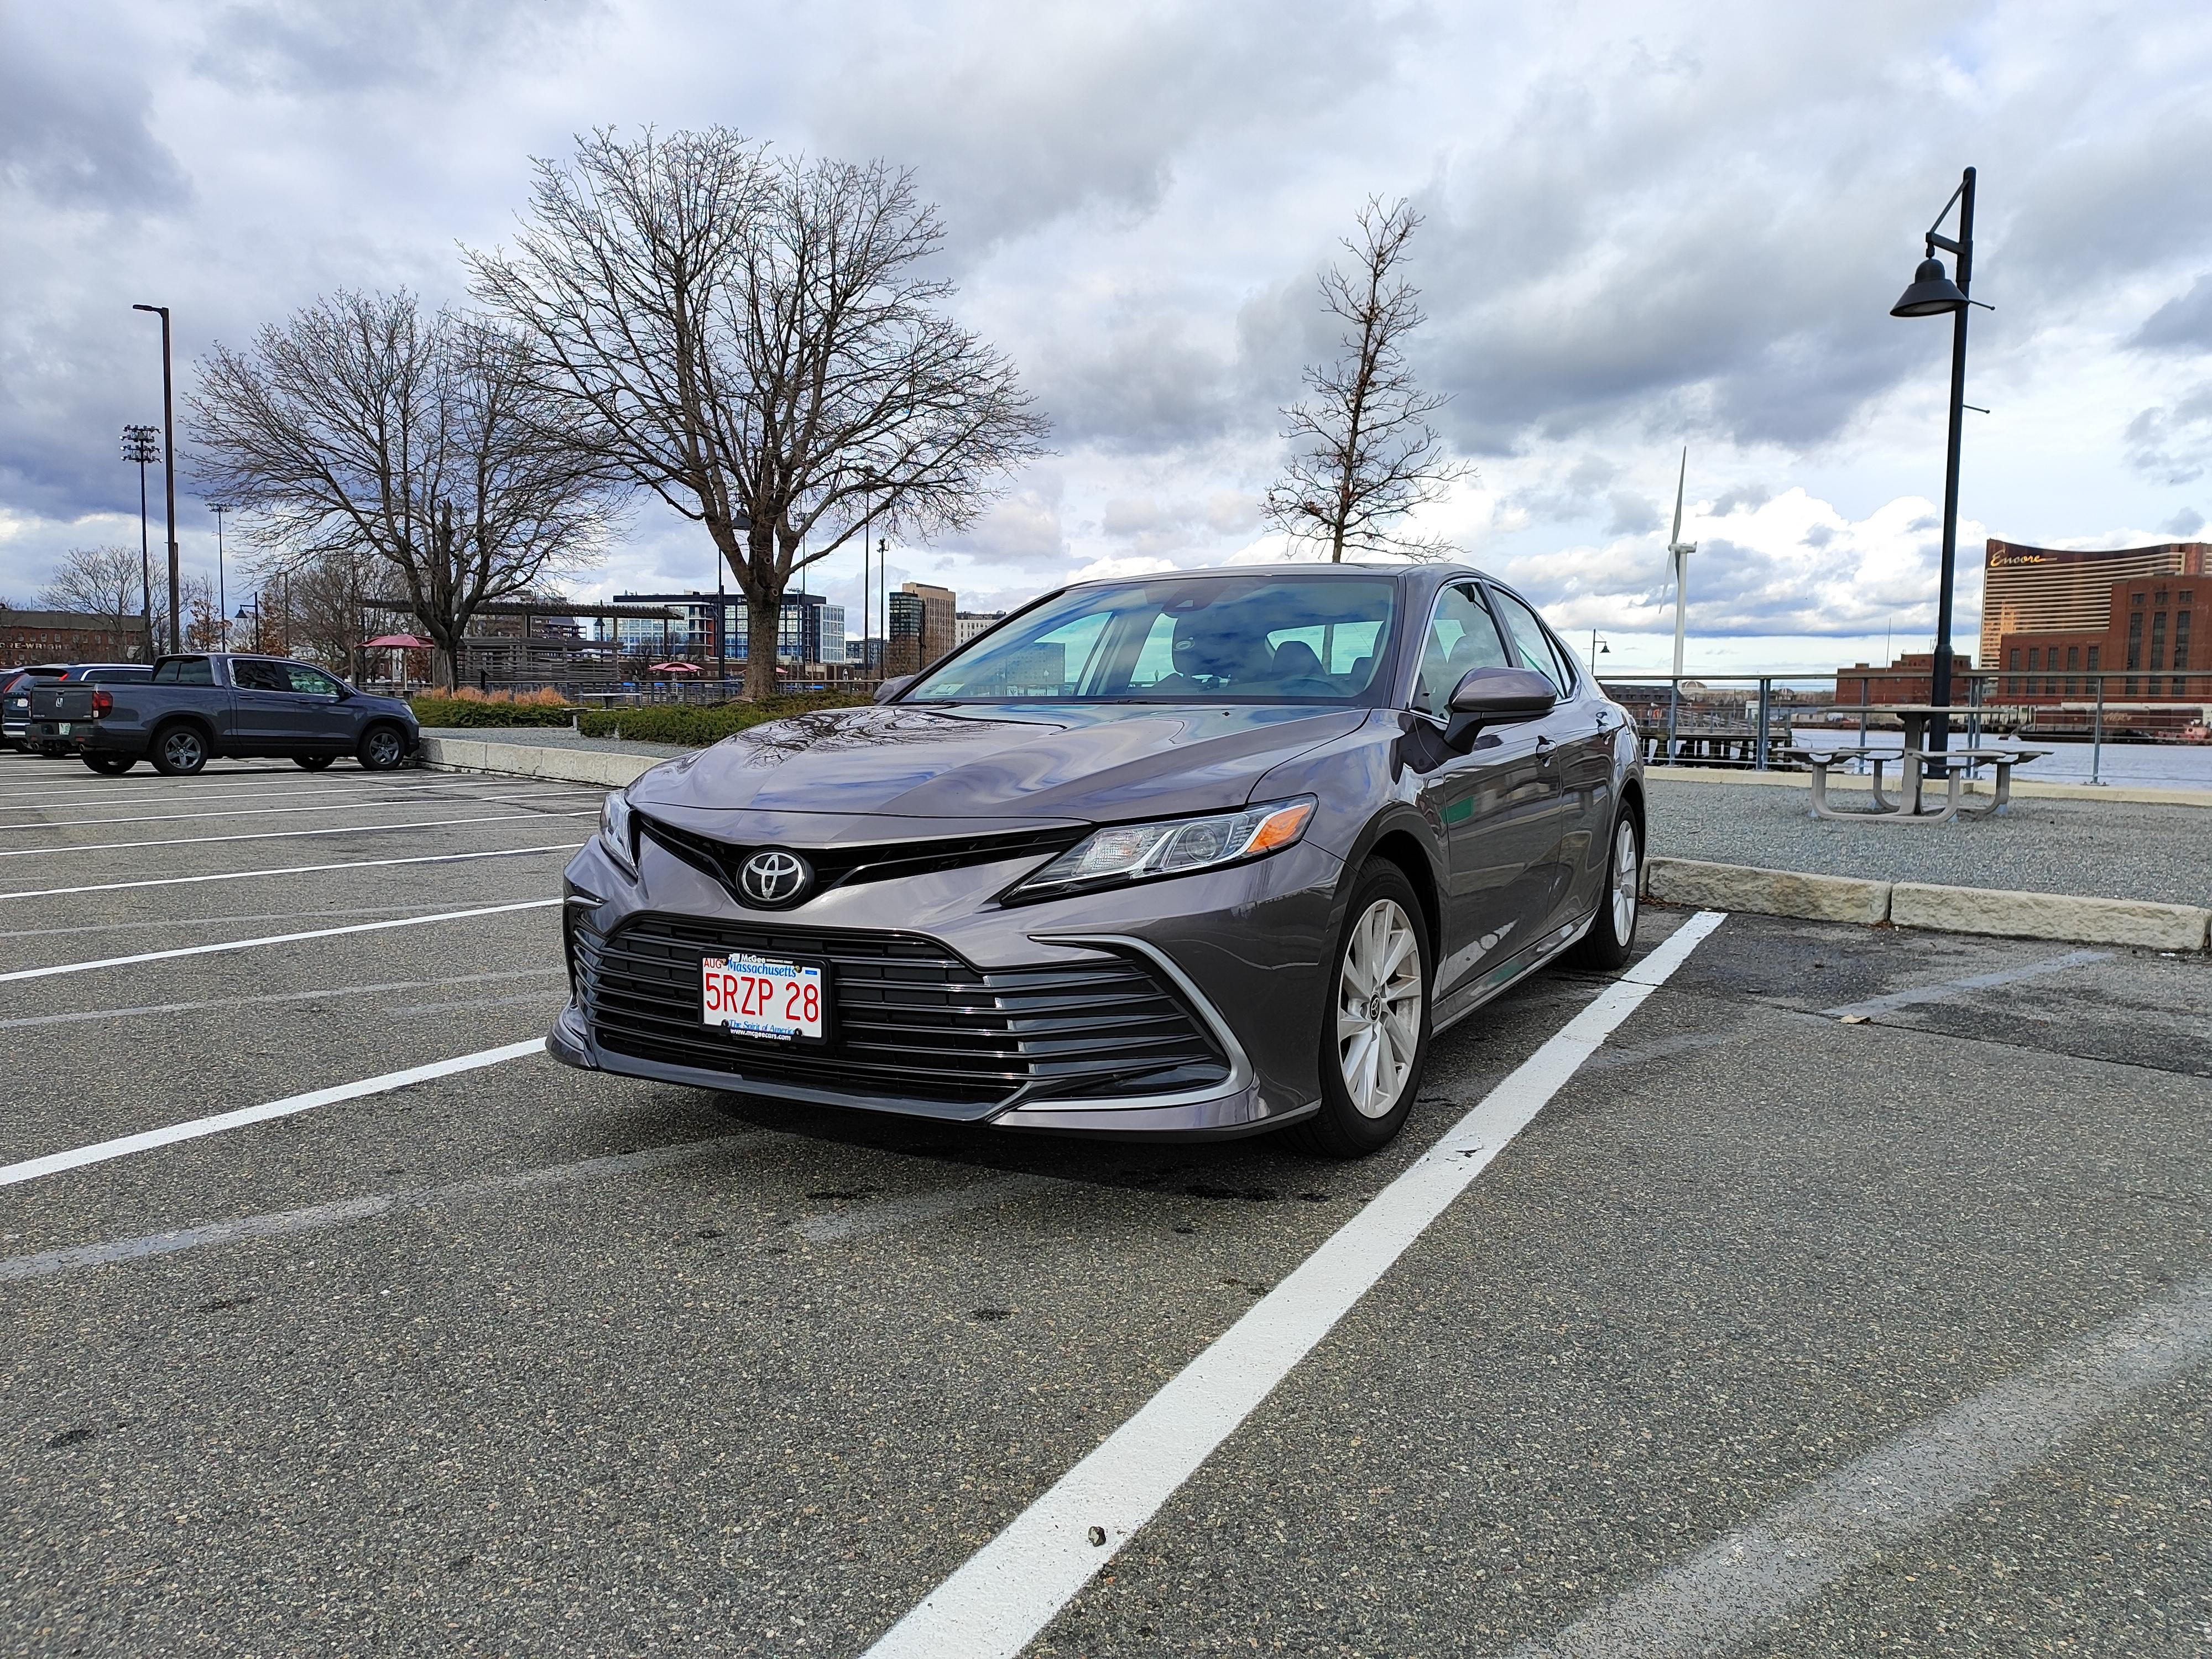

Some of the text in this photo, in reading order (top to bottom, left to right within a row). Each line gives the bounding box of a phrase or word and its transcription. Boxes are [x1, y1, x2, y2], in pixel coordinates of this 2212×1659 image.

[1990, 544, 2058, 567] Encore
[704, 958, 722, 969] AUG
[741, 953, 766, 963] McGee
[728, 960, 796, 978] Massachusetts
[705, 972, 818, 1022] 5RZP 28
[729, 1019, 742, 1027] The
[743, 1021, 760, 1030] Spirit
[730, 1029, 792, 1041] www.mcgeecars.com
